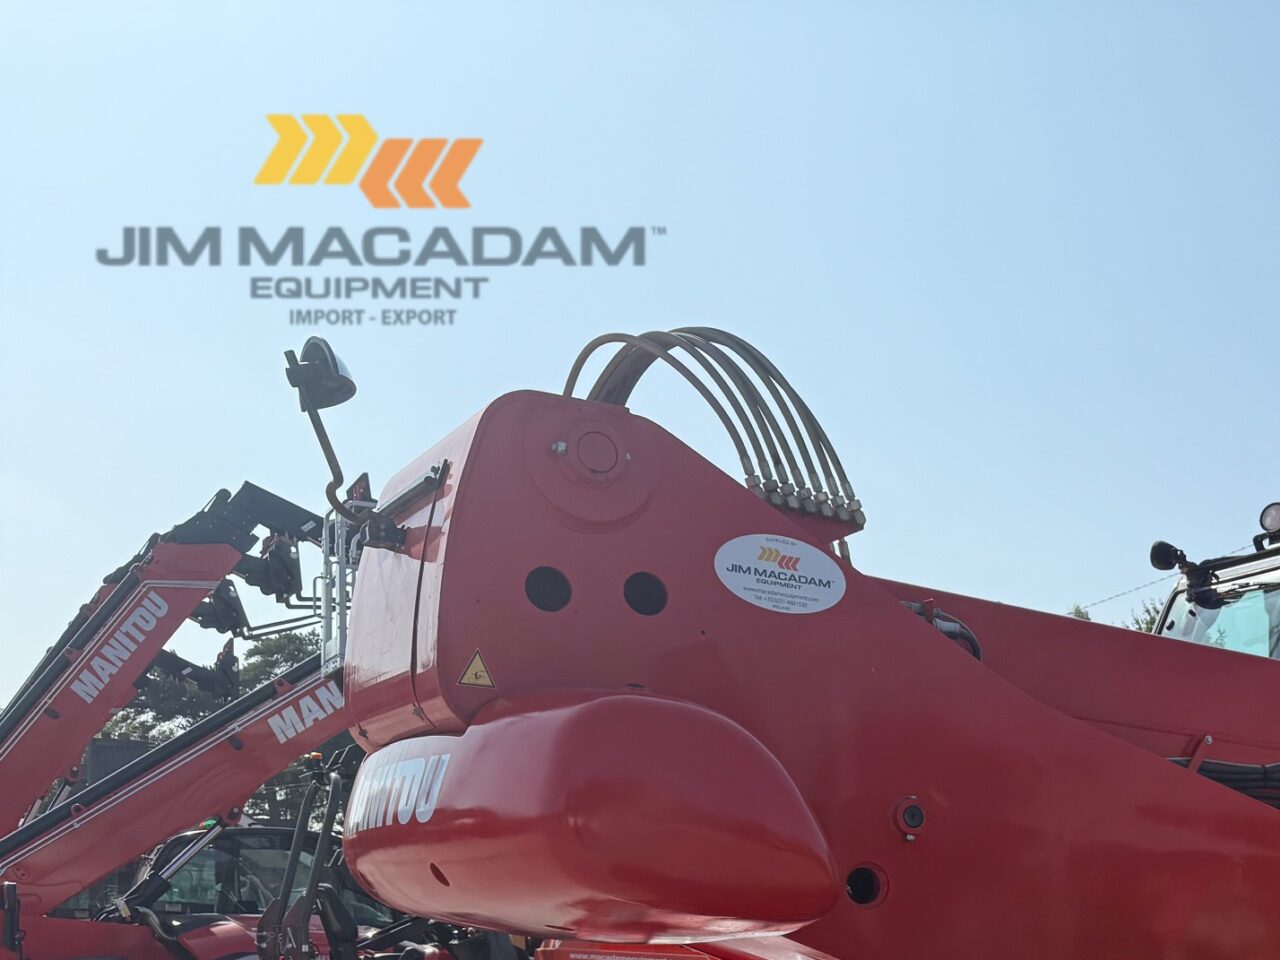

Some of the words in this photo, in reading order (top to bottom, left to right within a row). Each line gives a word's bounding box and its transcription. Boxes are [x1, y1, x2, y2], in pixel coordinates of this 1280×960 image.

[726, 563, 751, 576] JIM
[753, 567, 832, 589] MACADAM
[756, 578, 802, 590] EQUIPMENT
[70, 590, 169, 705] MANITOU
